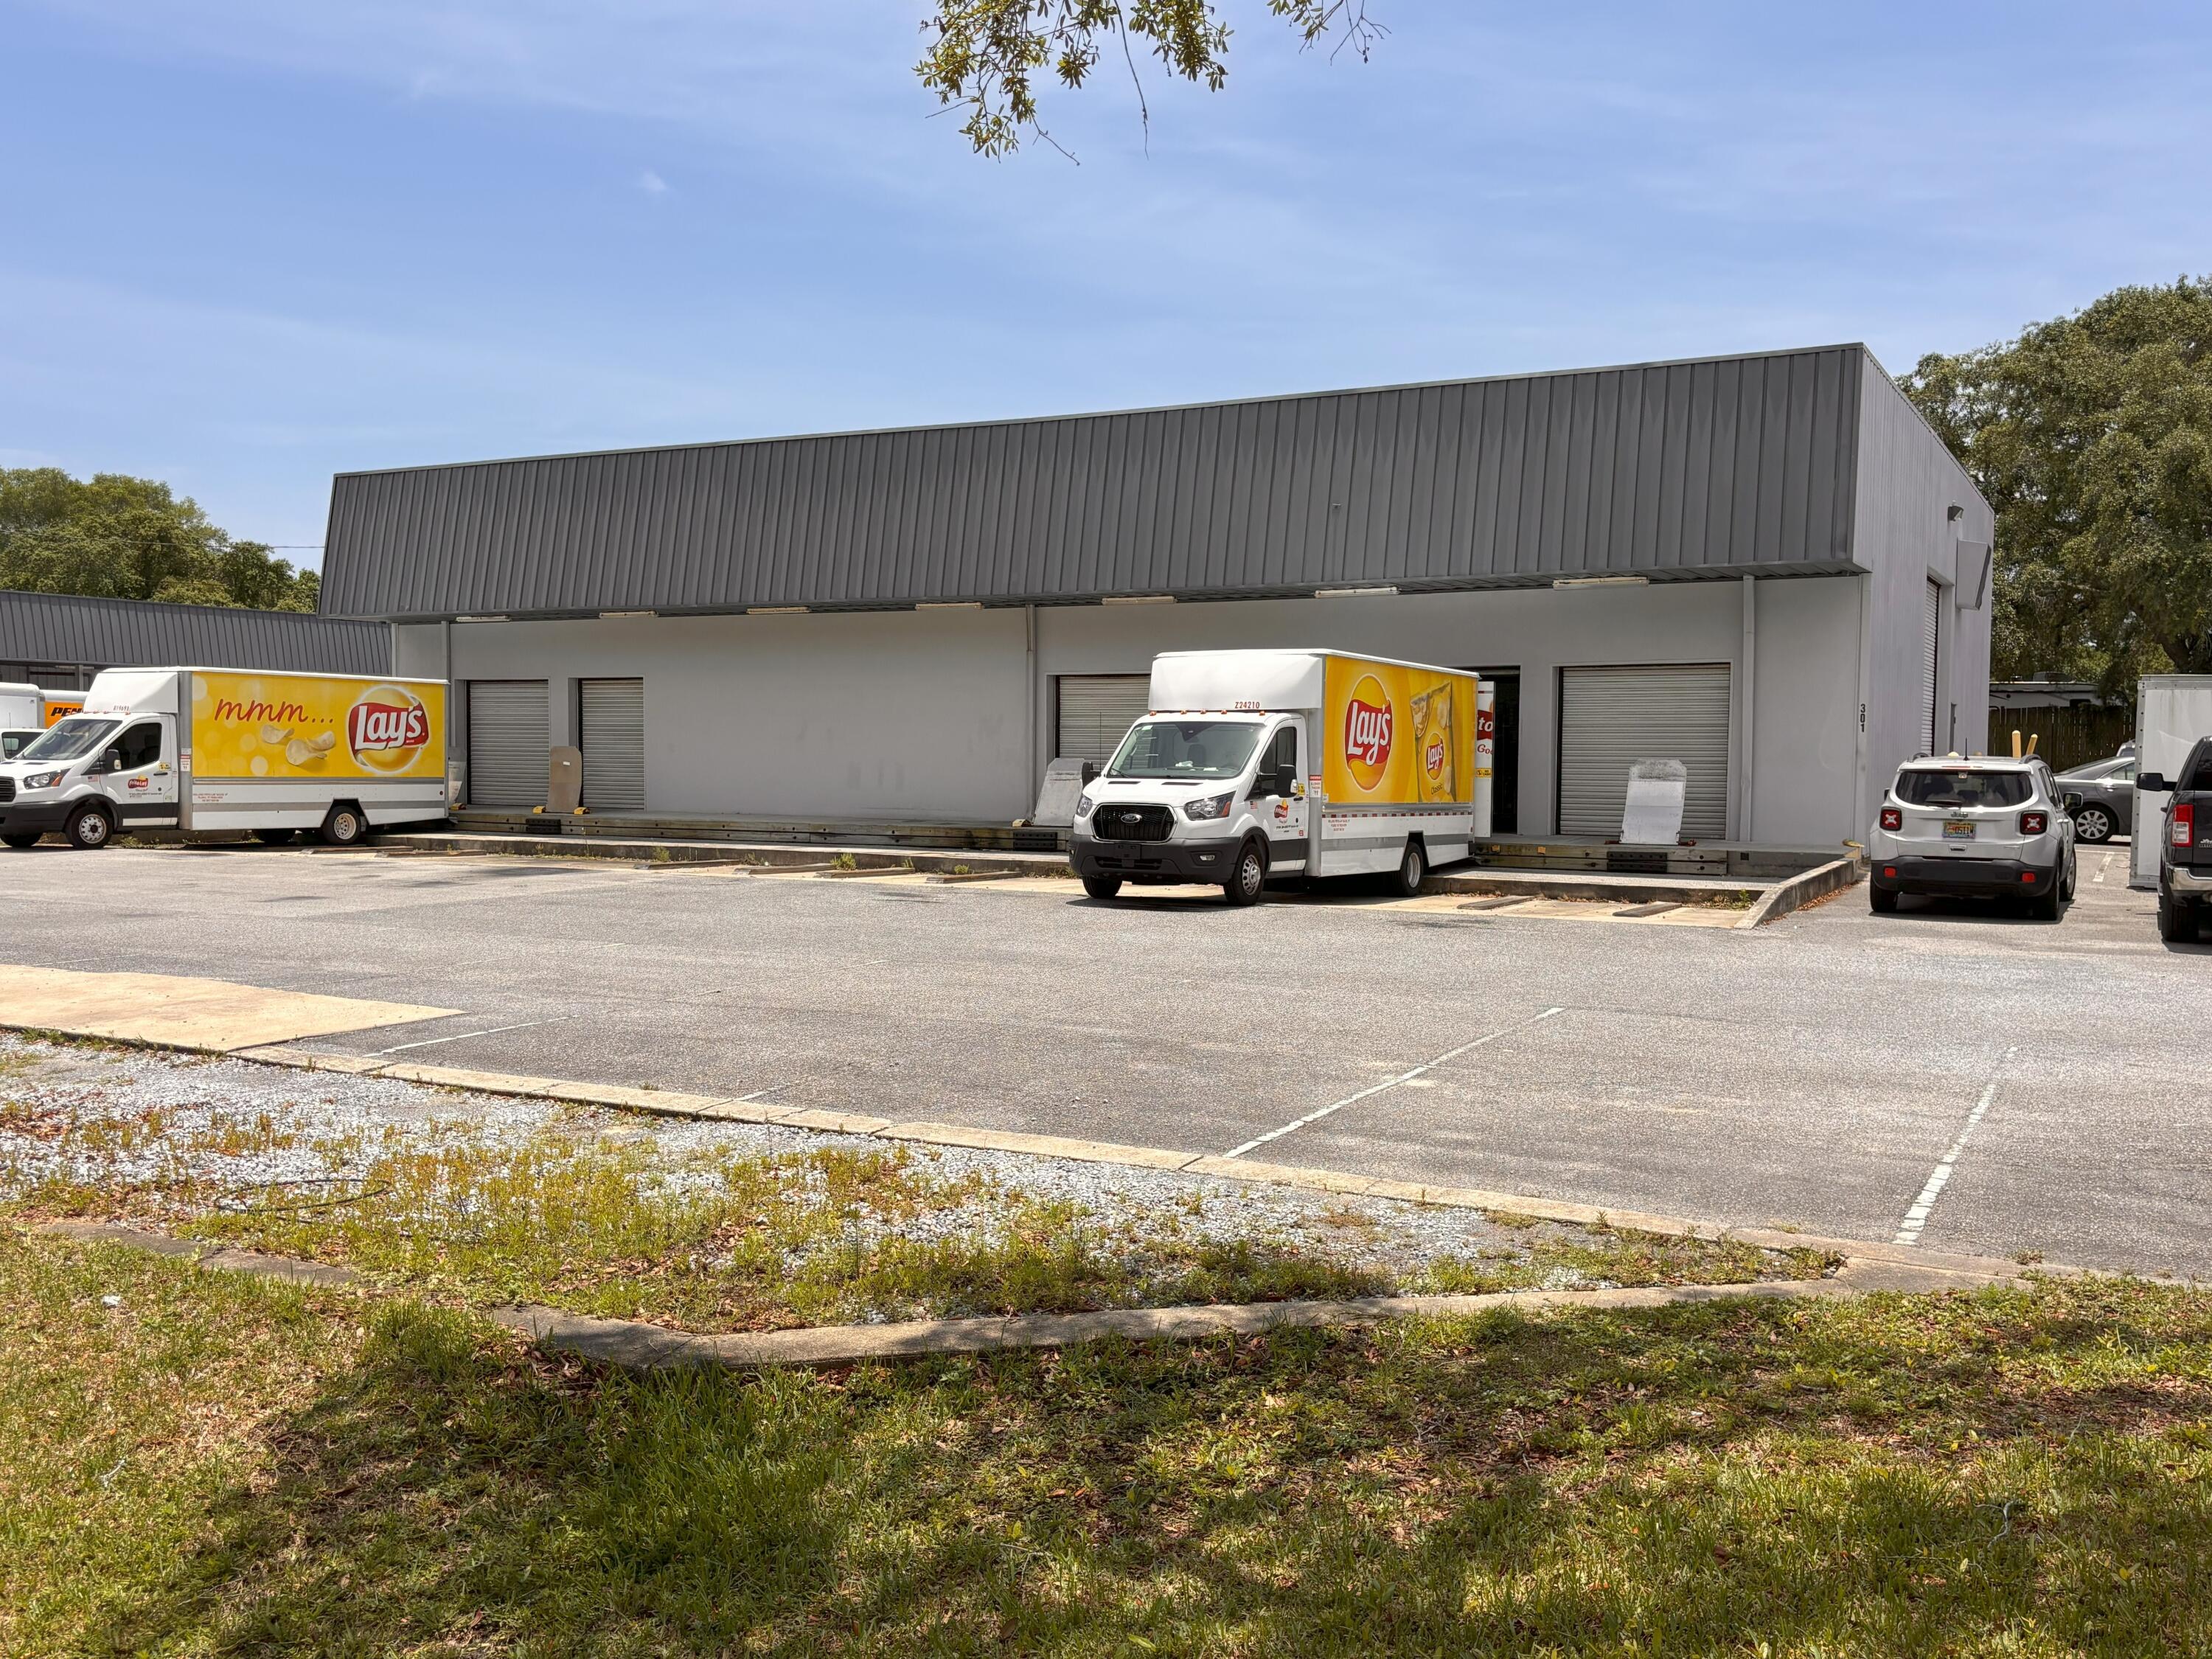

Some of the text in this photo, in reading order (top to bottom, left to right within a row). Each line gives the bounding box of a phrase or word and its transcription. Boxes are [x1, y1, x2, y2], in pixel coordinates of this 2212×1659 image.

[51, 707, 83, 716] PEN
[215, 699, 333, 723] mmm...
[1477, 717, 1493, 731] to
[355, 706, 422, 750] Lay's
[1347, 701, 1391, 766] Lay's
[1427, 740, 1443, 769] Lay's
